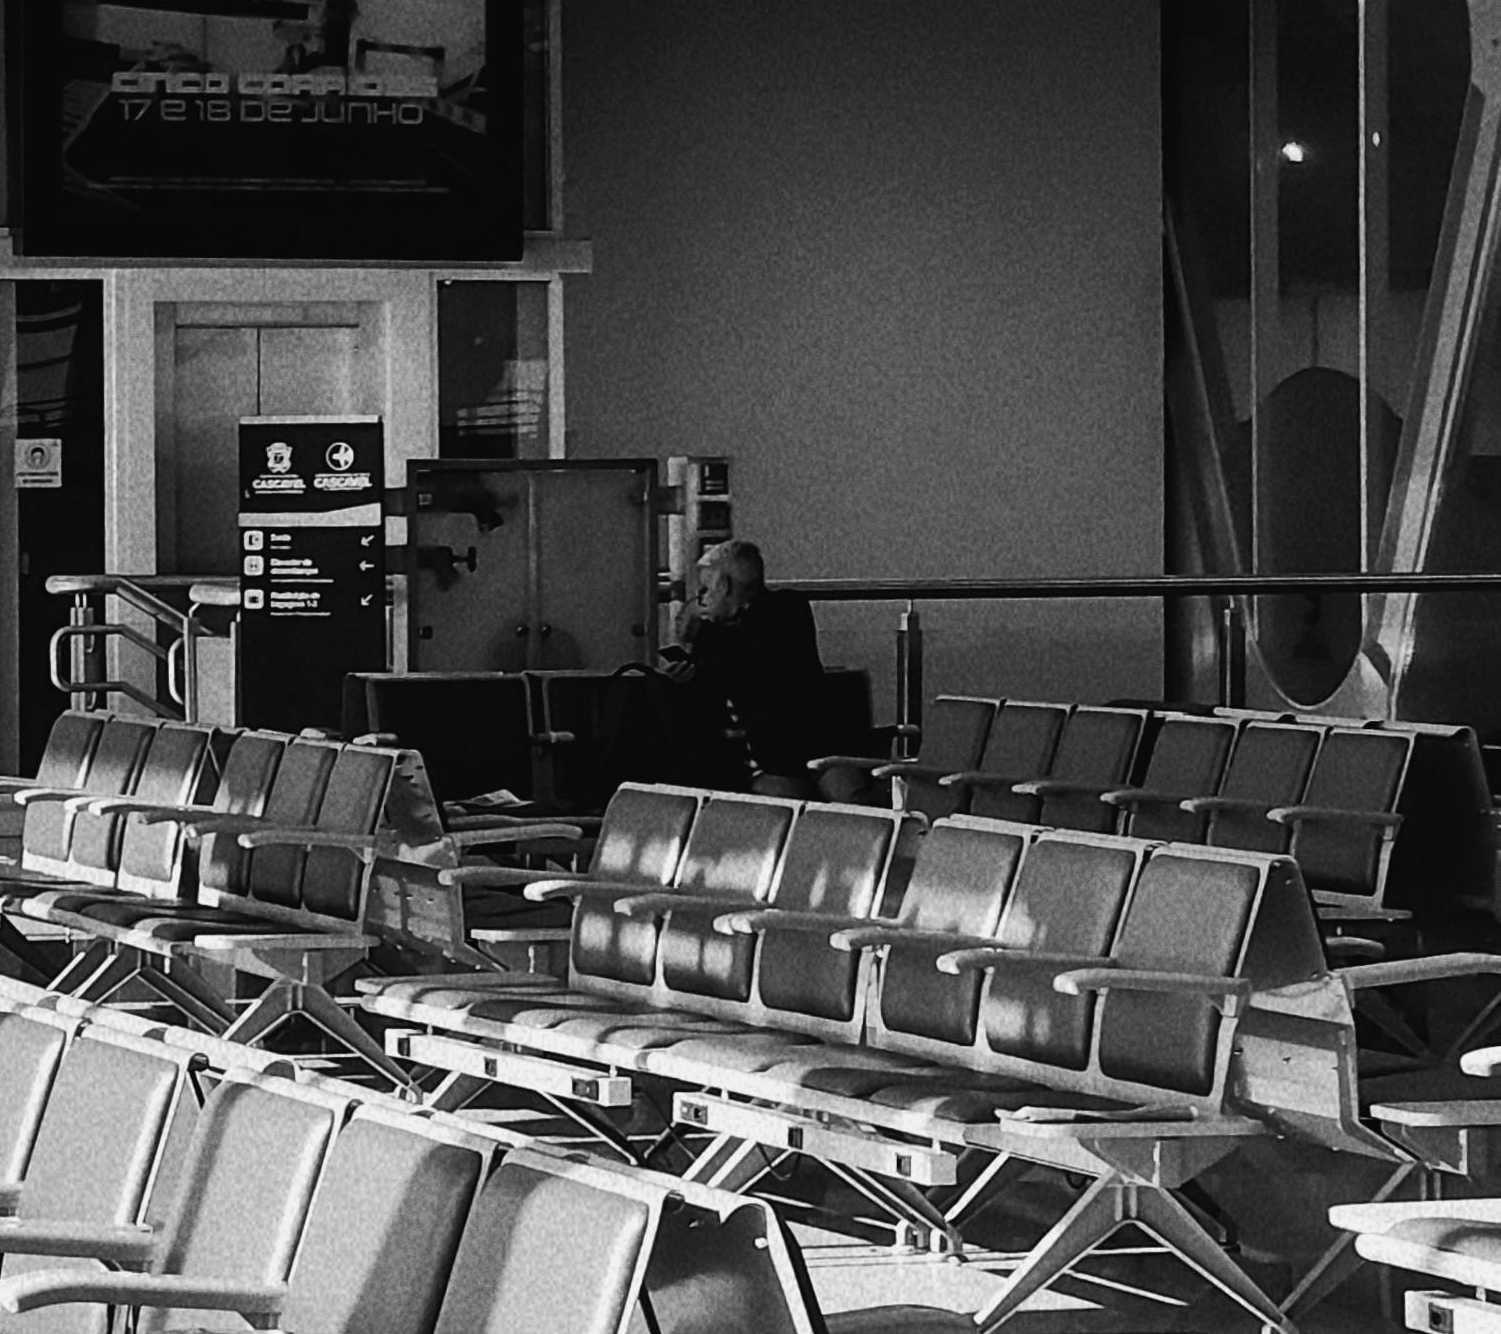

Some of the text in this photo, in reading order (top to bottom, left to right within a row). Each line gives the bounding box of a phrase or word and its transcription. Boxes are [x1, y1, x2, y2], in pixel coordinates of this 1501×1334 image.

[117, 98, 153, 121] 17
[194, 98, 232, 122] 18
[252, 478, 307, 488] CASCAVEL
[313, 477, 373, 488] CASCAVEL
